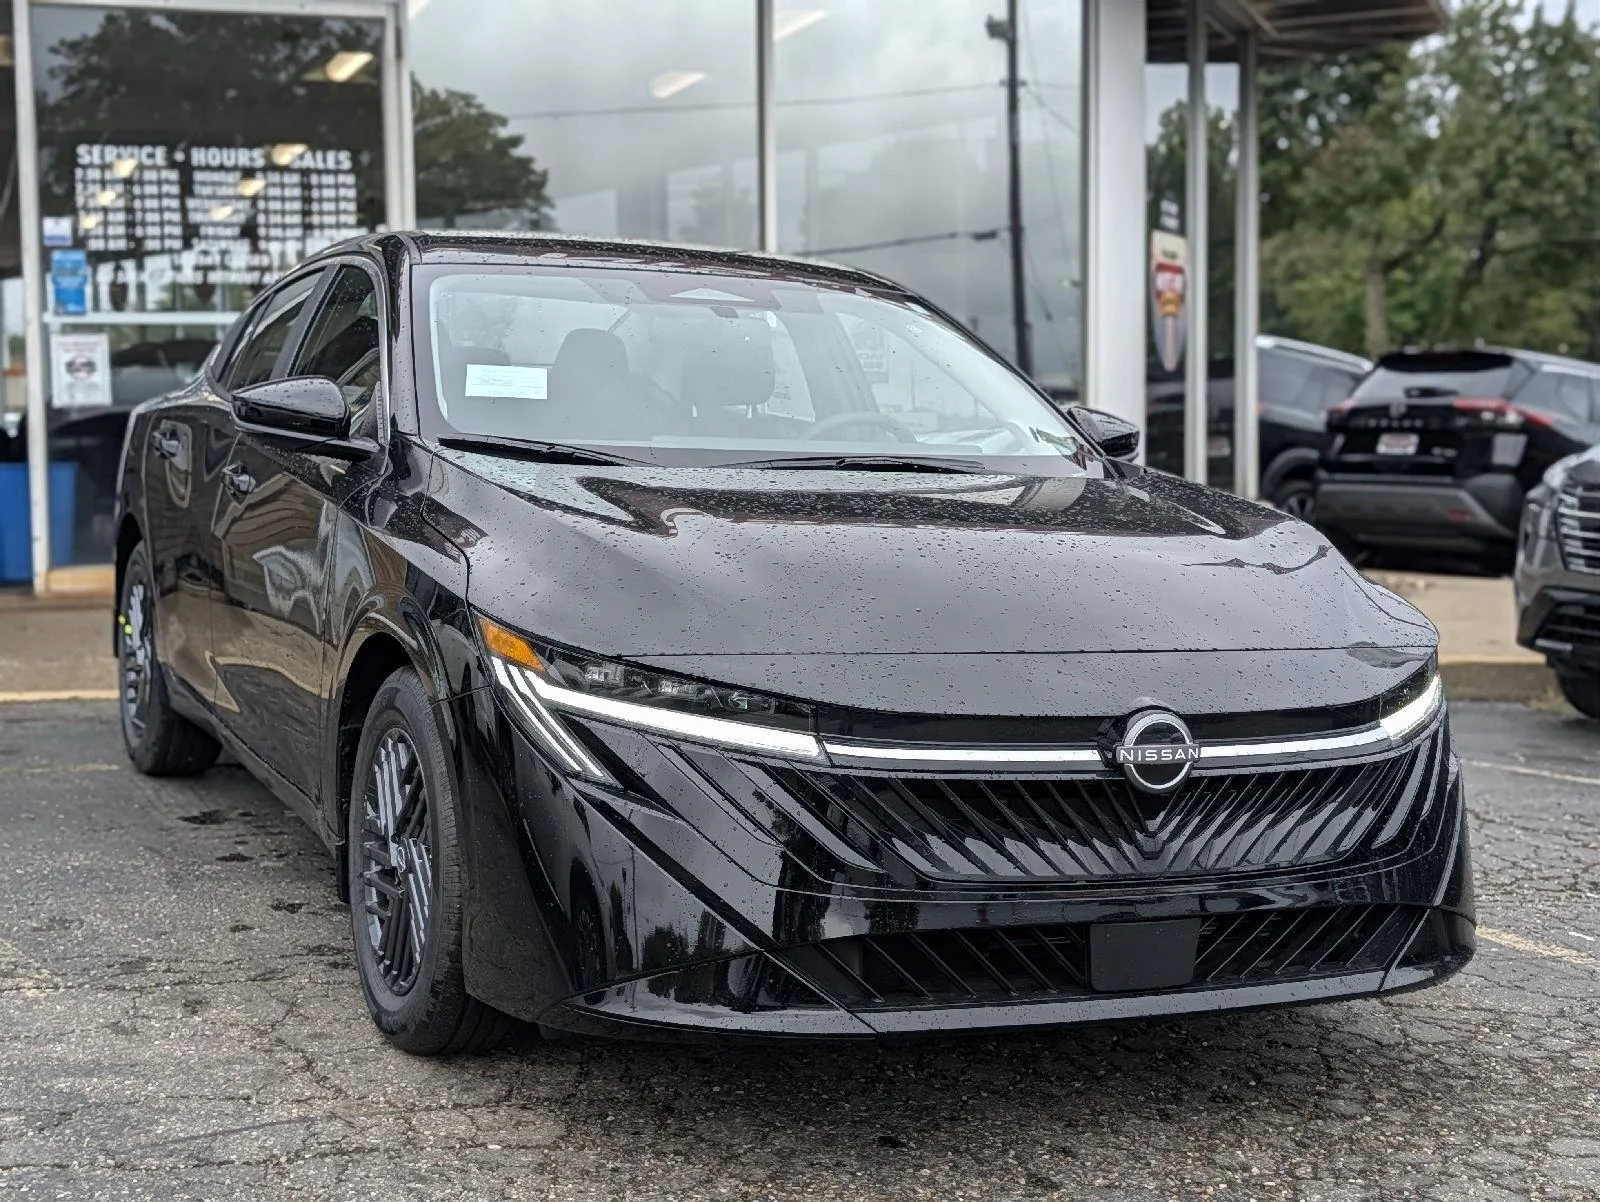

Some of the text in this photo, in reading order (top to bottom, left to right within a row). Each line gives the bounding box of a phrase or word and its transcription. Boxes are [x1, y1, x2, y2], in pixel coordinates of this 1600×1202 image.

[76, 143, 168, 166] SERVICE
[190, 146, 265, 168] HOURS
[1118, 747, 1199, 762] NISSAN
